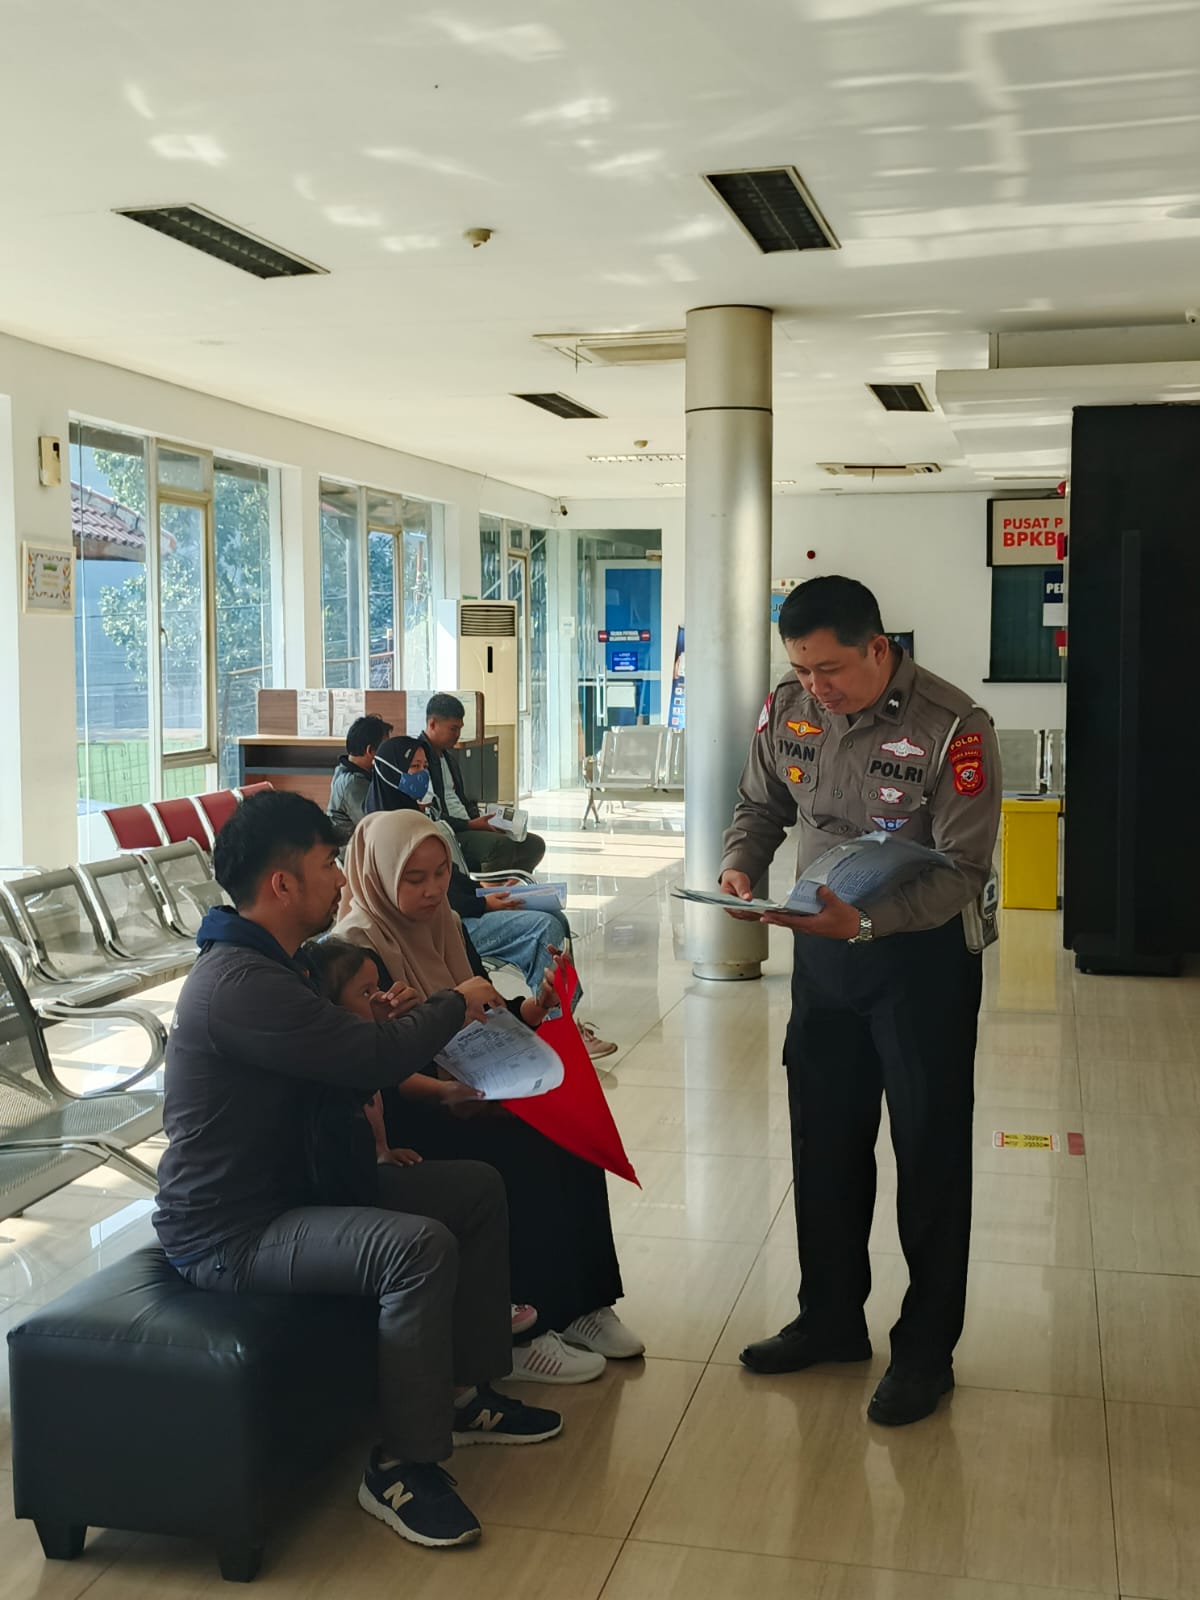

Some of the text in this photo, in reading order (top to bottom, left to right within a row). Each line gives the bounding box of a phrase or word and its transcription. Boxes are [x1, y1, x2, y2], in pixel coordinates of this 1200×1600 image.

[1003, 517, 1050, 530] PUSAT
[1003, 531, 1056, 547] BPKB
[779, 739, 815, 762] IYAN
[950, 735, 979, 751] POLDA
[869, 760, 923, 783] POLRI
[469, 1408, 505, 1430] N
[382, 1481, 414, 1512] N
